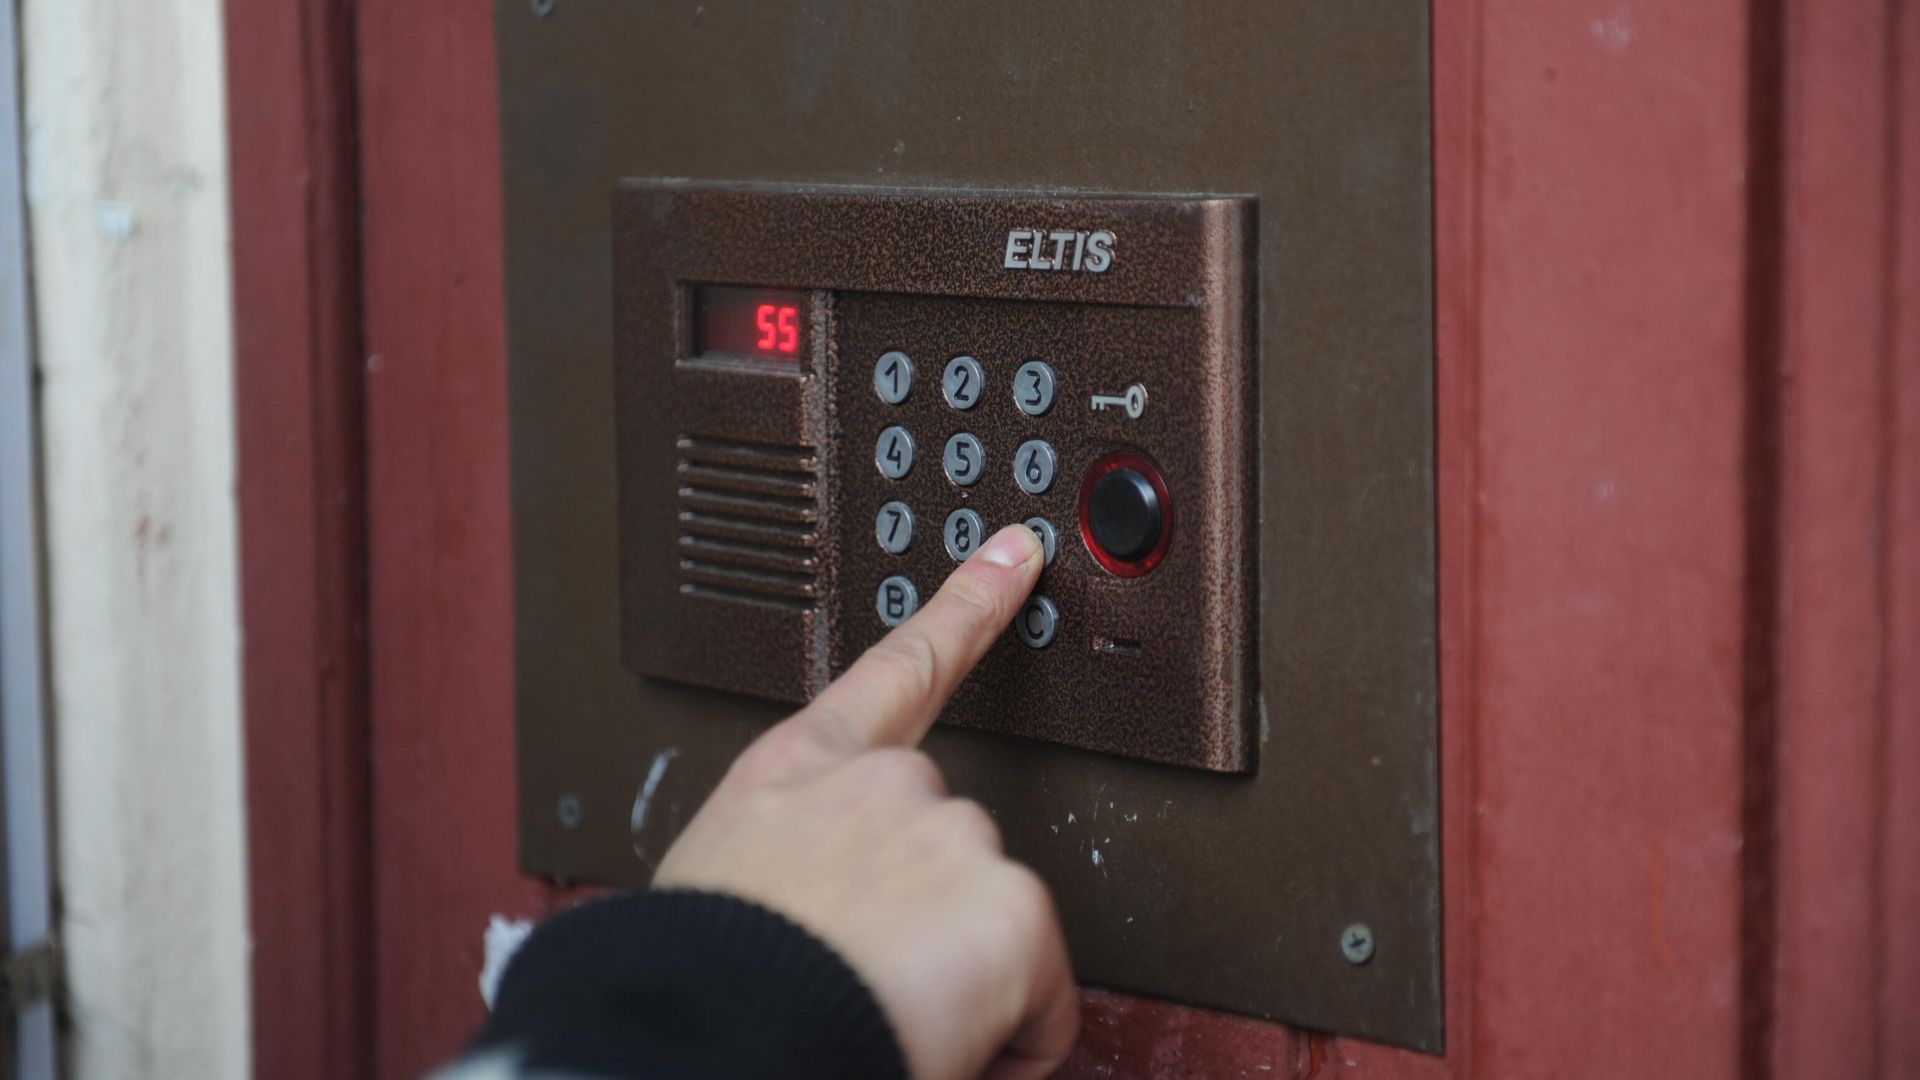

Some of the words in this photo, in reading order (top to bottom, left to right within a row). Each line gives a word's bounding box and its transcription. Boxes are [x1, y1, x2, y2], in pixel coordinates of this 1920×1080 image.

[1004, 228, 1117, 273] ELTIS
[756, 304, 800, 353] 55
[885, 361, 899, 397] 1
[953, 365, 970, 401] 2
[1024, 370, 1041, 406] 3
[886, 437, 901, 471] 4
[954, 442, 971, 477] 5
[1025, 449, 1041, 485] 6
[886, 510, 901, 542] 7
[955, 517, 970, 553] 8
[886, 584, 904, 618] B
[1025, 605, 1044, 639] C
